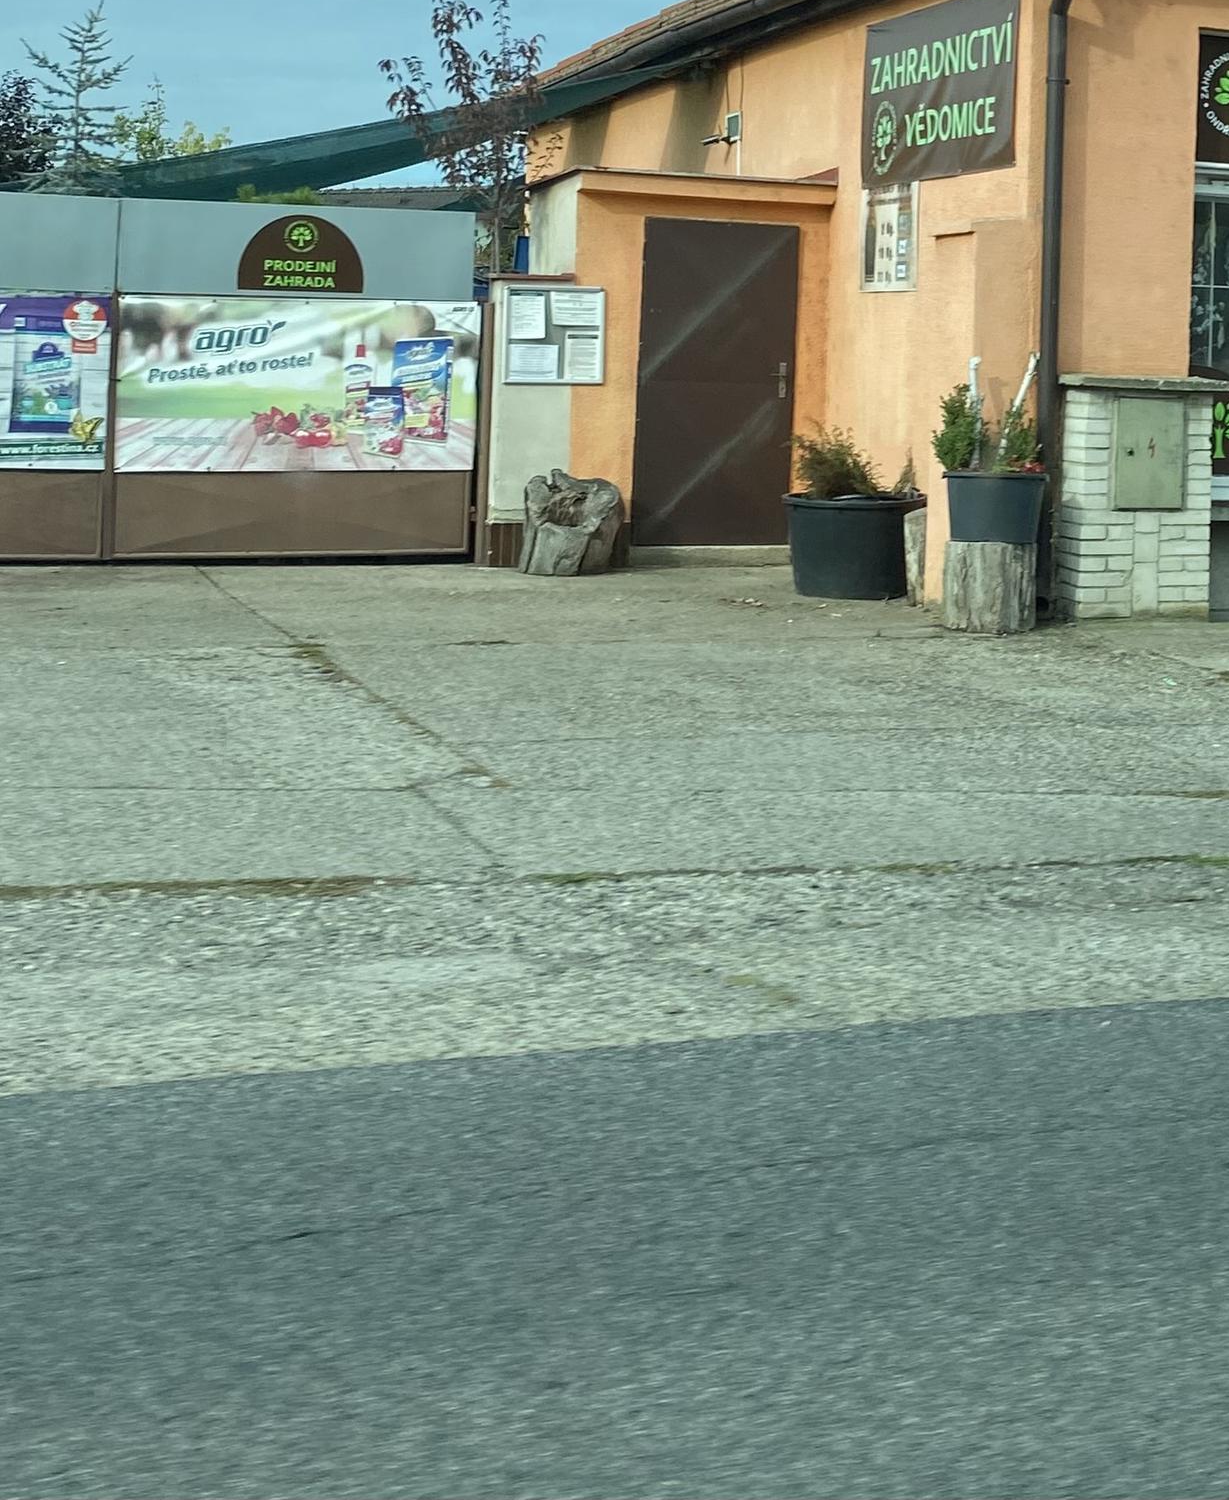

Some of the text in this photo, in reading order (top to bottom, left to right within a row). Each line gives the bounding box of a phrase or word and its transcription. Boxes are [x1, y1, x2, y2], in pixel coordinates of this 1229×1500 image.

[870, 12, 1013, 95] ZAHRADNICTVÍ
[905, 97, 997, 148] VĚDOMICE
[263, 259, 337, 273] PRODEJNÍ
[263, 275, 335, 288] ZAHRADA
[239, 360, 257, 375] to
[261, 352, 314, 371] roste!
